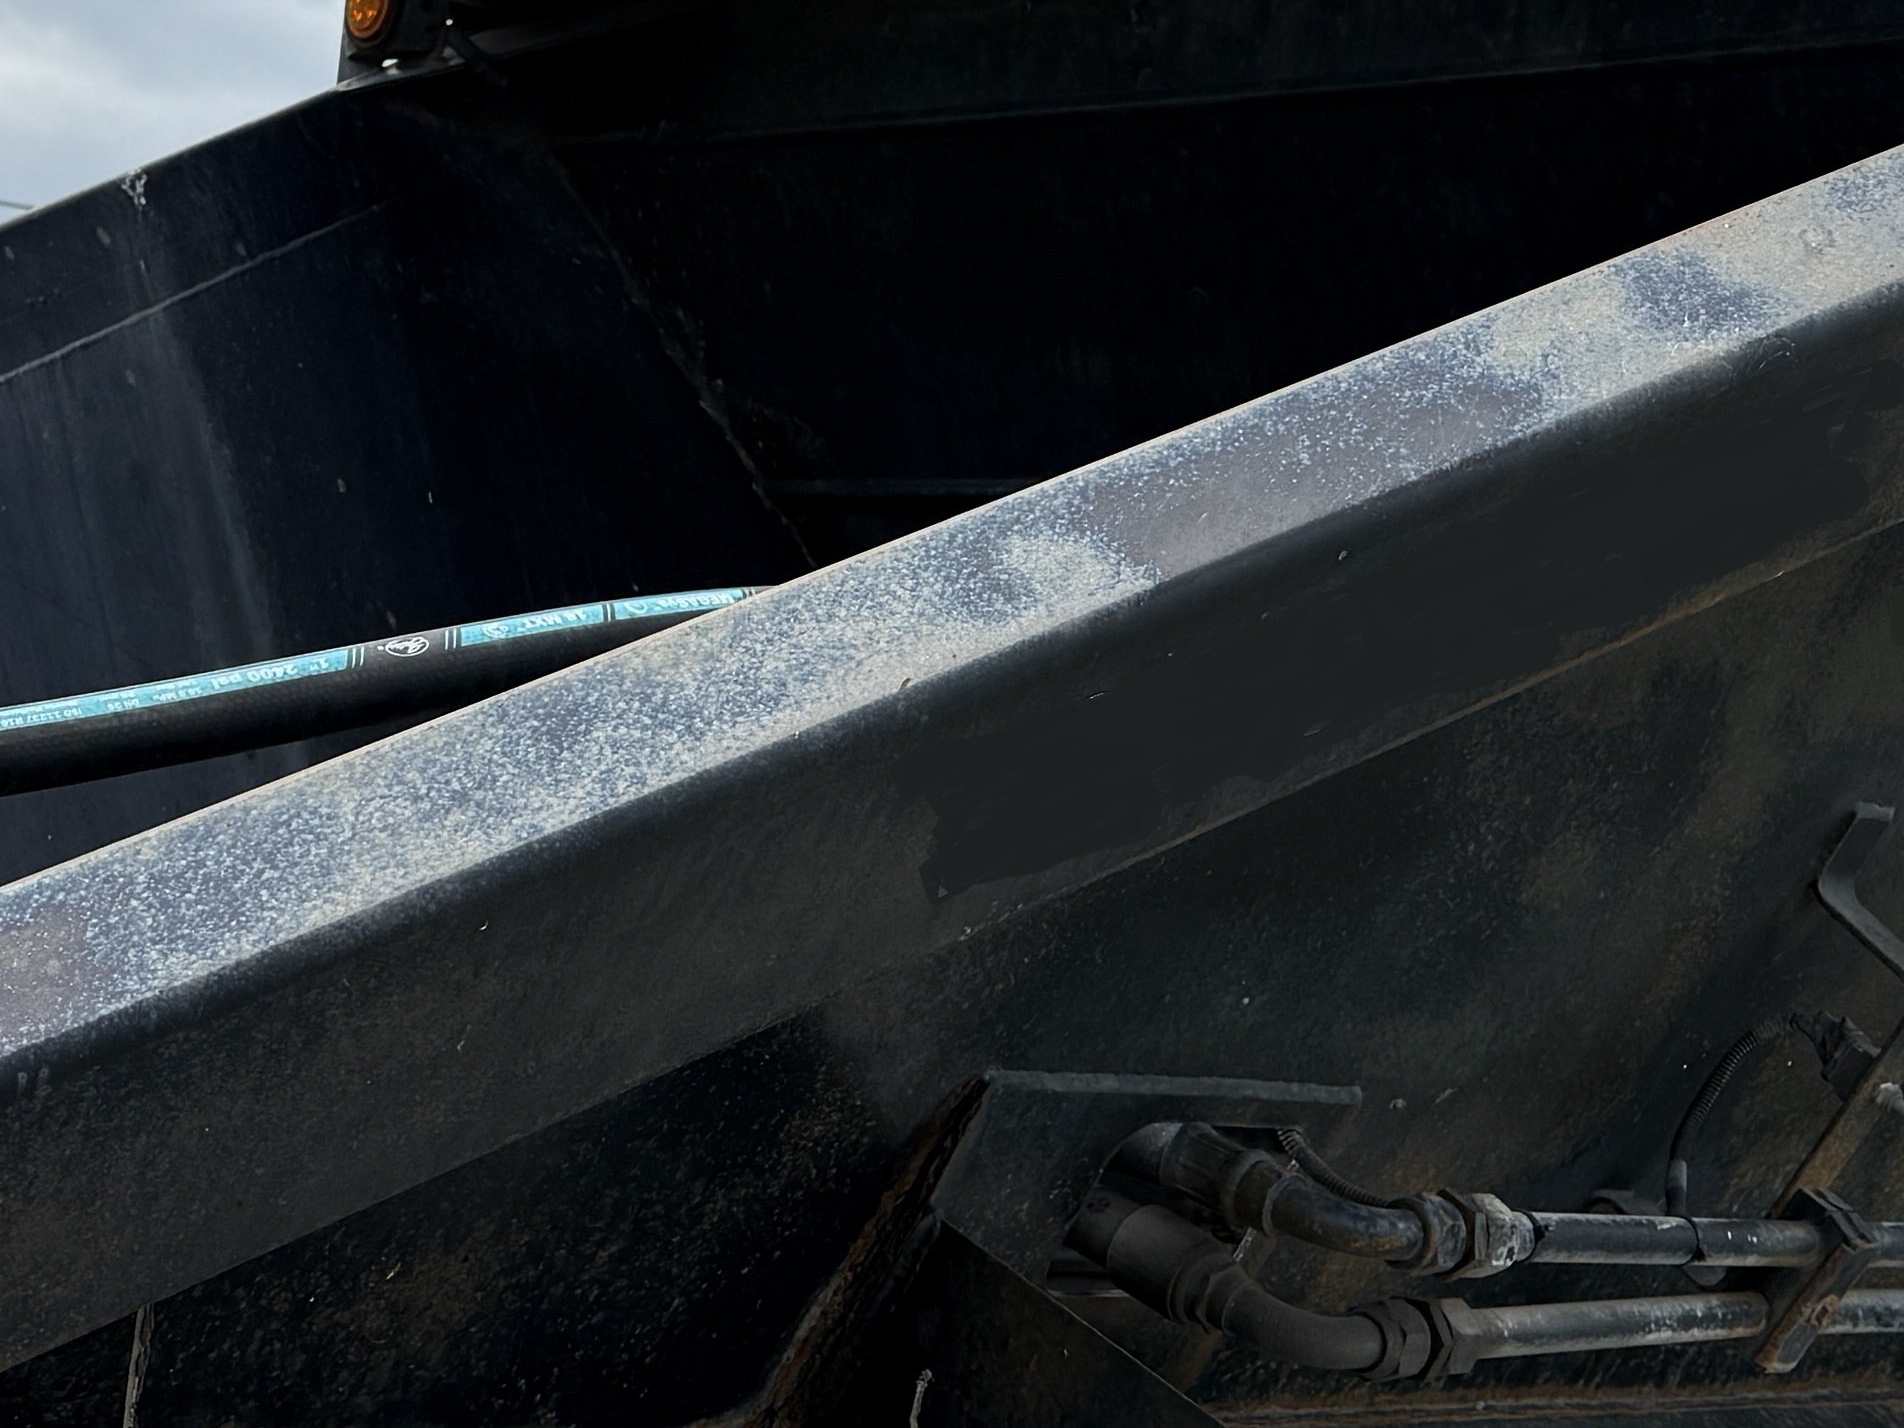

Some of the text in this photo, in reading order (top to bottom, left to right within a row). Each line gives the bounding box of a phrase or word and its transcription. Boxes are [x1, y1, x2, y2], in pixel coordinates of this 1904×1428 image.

[525, 613, 560, 627] MXT
[209, 671, 243, 687] psi
[246, 664, 297, 681] 2400
